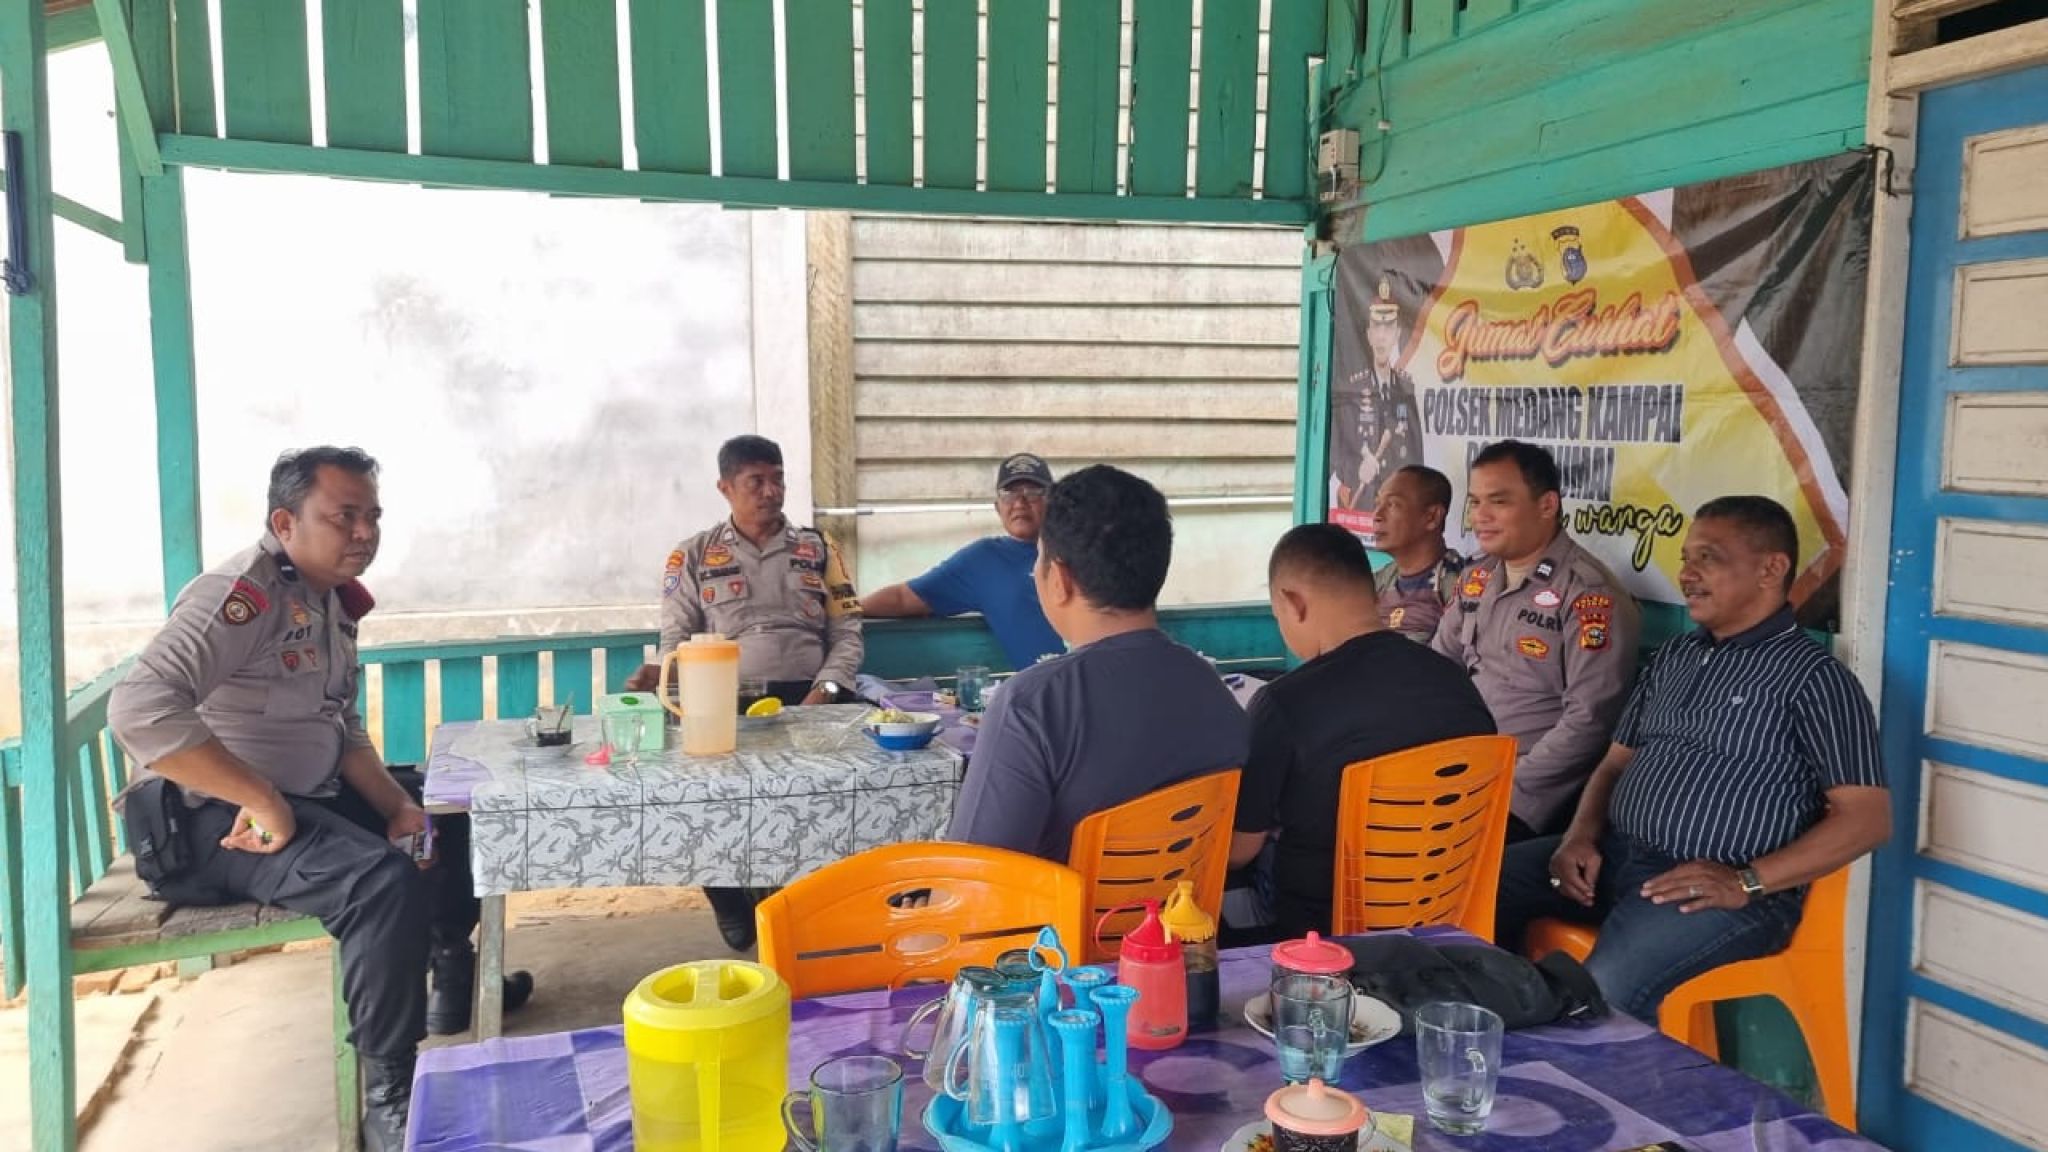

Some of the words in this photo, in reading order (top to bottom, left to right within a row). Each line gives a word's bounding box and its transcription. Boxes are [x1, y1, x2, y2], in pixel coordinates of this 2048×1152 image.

[1543, 288, 1682, 367] Curhat
[1424, 388, 1491, 437] POLSEK
[1495, 386, 1583, 440] MEDANG
[1587, 384, 1683, 443] KAMPAI
[1545, 445, 1615, 501] UMAI
[1574, 503, 1683, 572] warga
